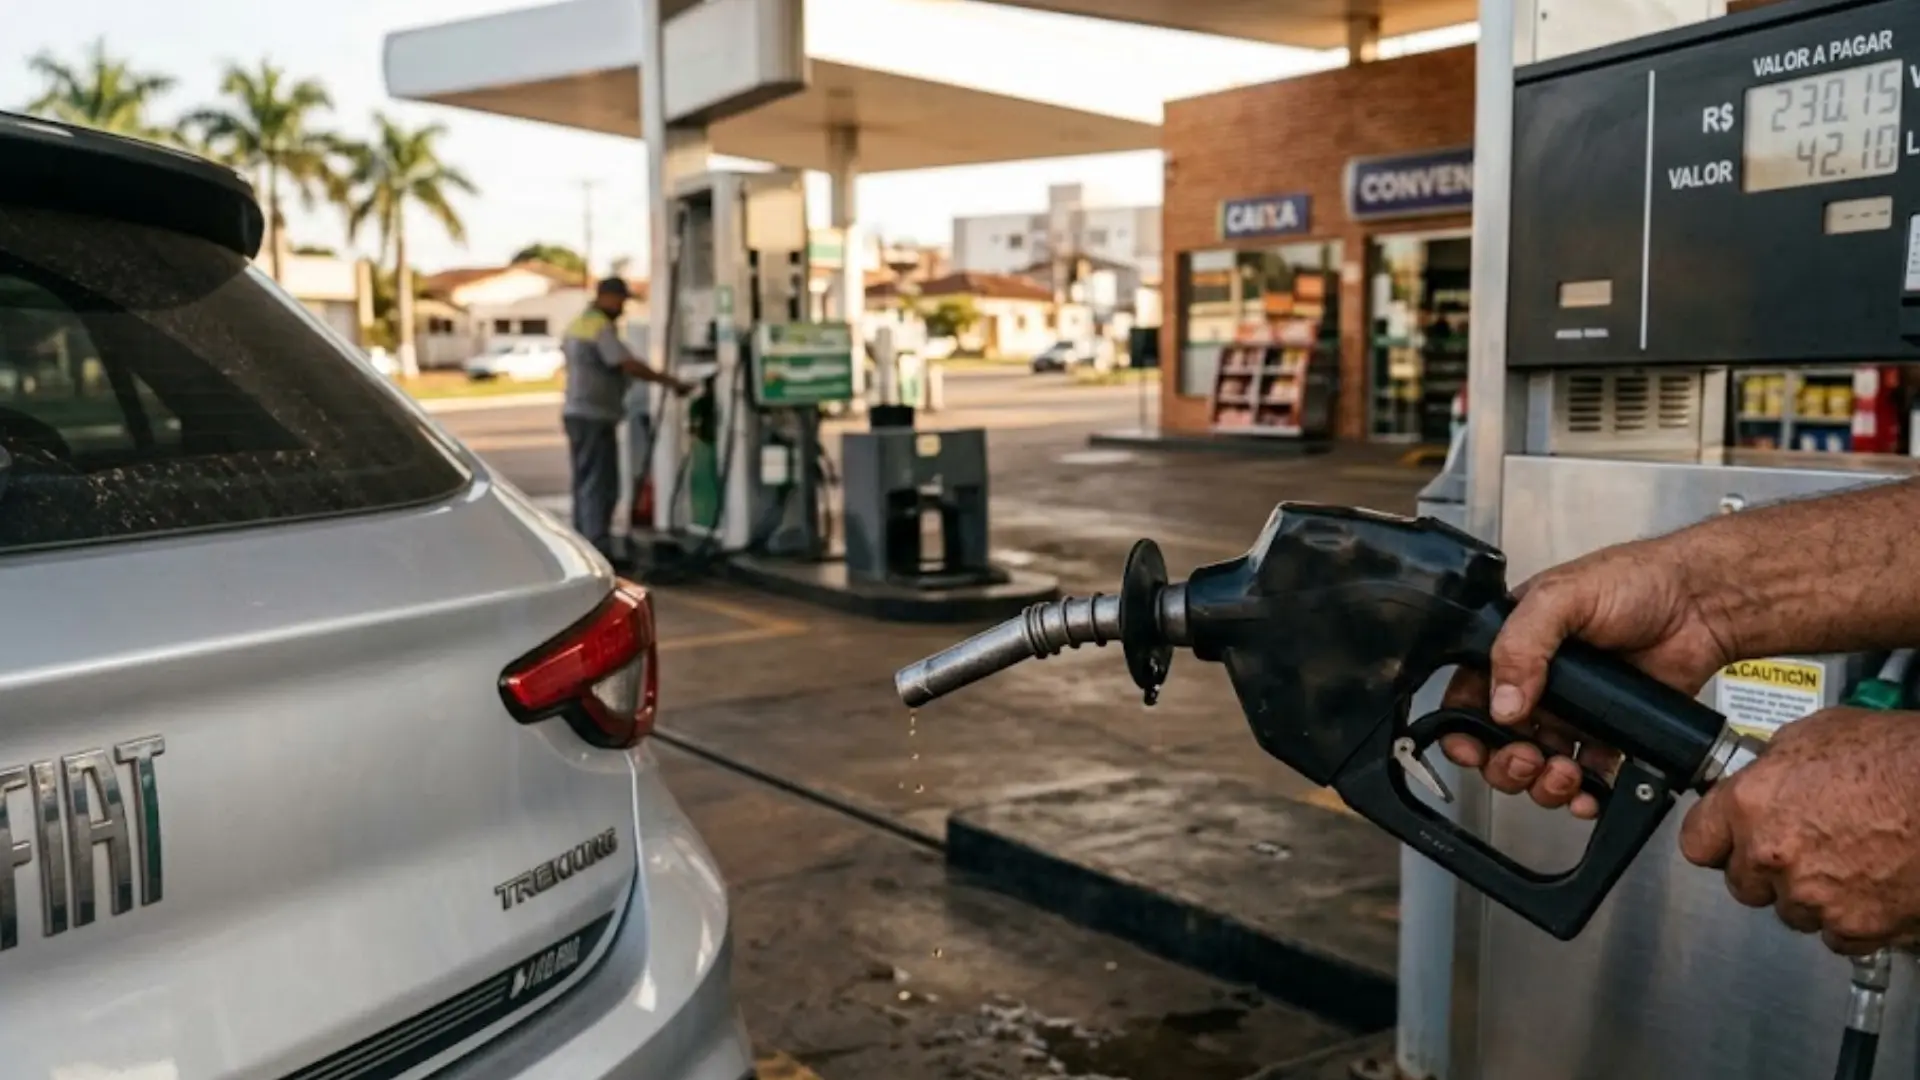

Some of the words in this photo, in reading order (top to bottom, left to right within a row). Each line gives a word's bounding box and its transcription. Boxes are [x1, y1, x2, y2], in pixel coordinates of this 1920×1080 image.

[1752, 47, 1809, 77] VALOR
[1812, 47, 1826, 66] A
[1829, 30, 1893, 62] PAGAR
[1702, 102, 1734, 133] R$
[1771, 68, 1898, 132] 230.15
[1668, 160, 1733, 190] VALOR
[1796, 123, 1896, 177] 42.10
[0, 733, 165, 951] FIAT
